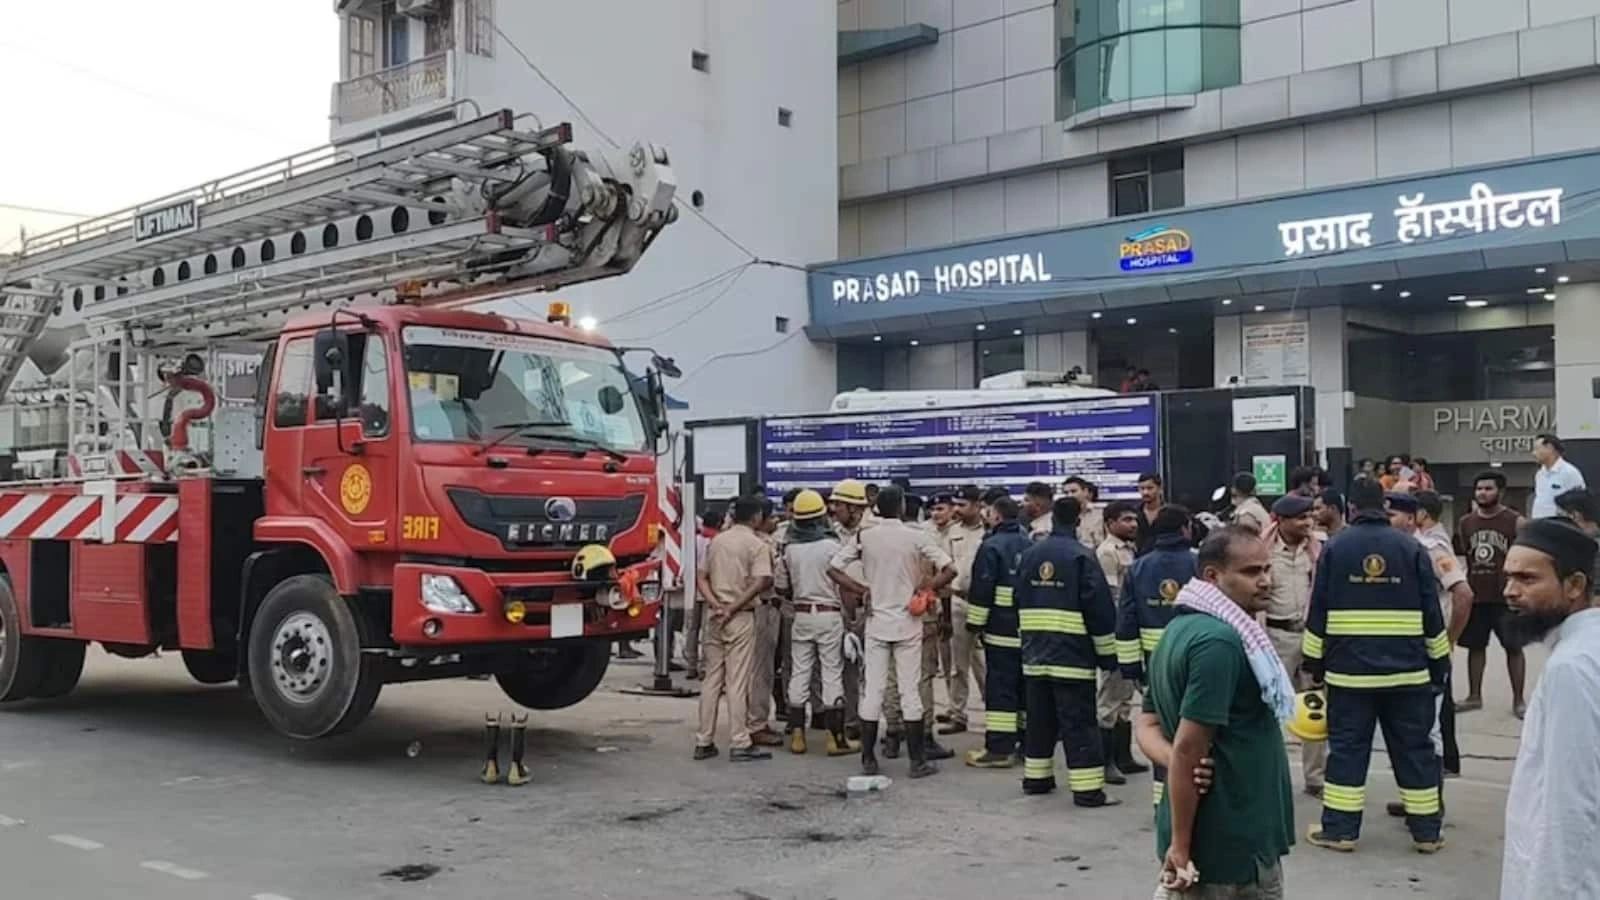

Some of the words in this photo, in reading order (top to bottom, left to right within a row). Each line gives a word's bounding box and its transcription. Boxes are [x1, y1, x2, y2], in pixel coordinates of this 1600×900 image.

[136, 203, 193, 239] LIFTMAK
[1278, 212, 1373, 256] प्रसाद
[1120, 235, 1191, 258] PRASAD
[1130, 253, 1179, 267] HOSPITAL
[833, 269, 920, 303] PRASAD
[934, 252, 1052, 294] HOSPITAL
[1433, 405, 1557, 432] PHARM
[508, 523, 608, 541] EICHER
